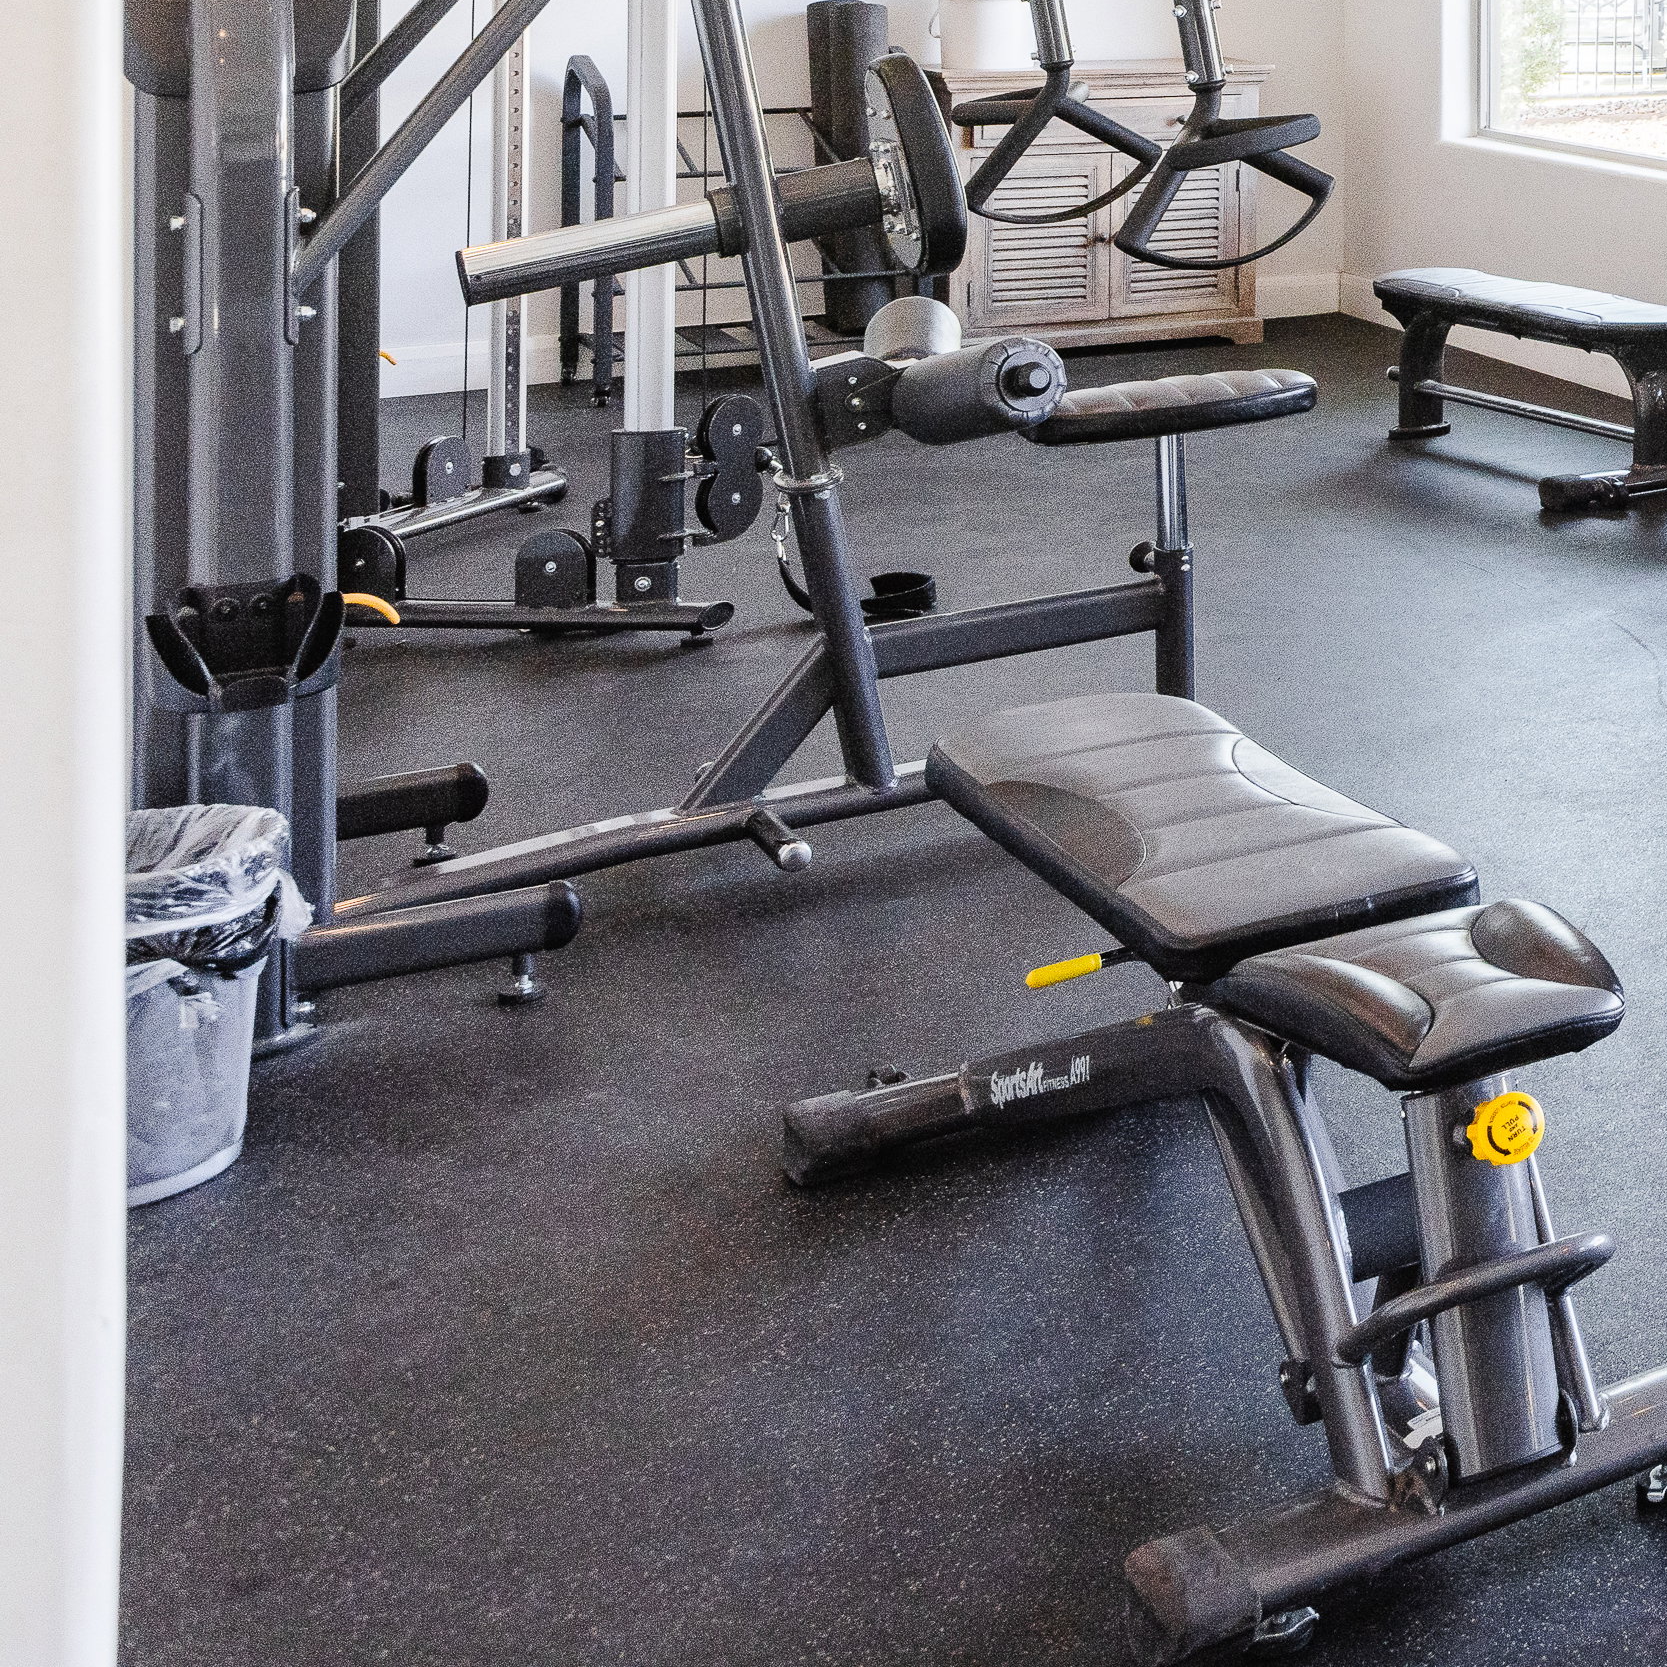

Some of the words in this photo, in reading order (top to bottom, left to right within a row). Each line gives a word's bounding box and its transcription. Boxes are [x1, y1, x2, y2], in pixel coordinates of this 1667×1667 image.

[991, 1061, 1044, 1110] SportsArt
[1069, 1055, 1091, 1085] A991
[1501, 1115, 1520, 1130] PULL
[1507, 1125, 1527, 1142] TURN
